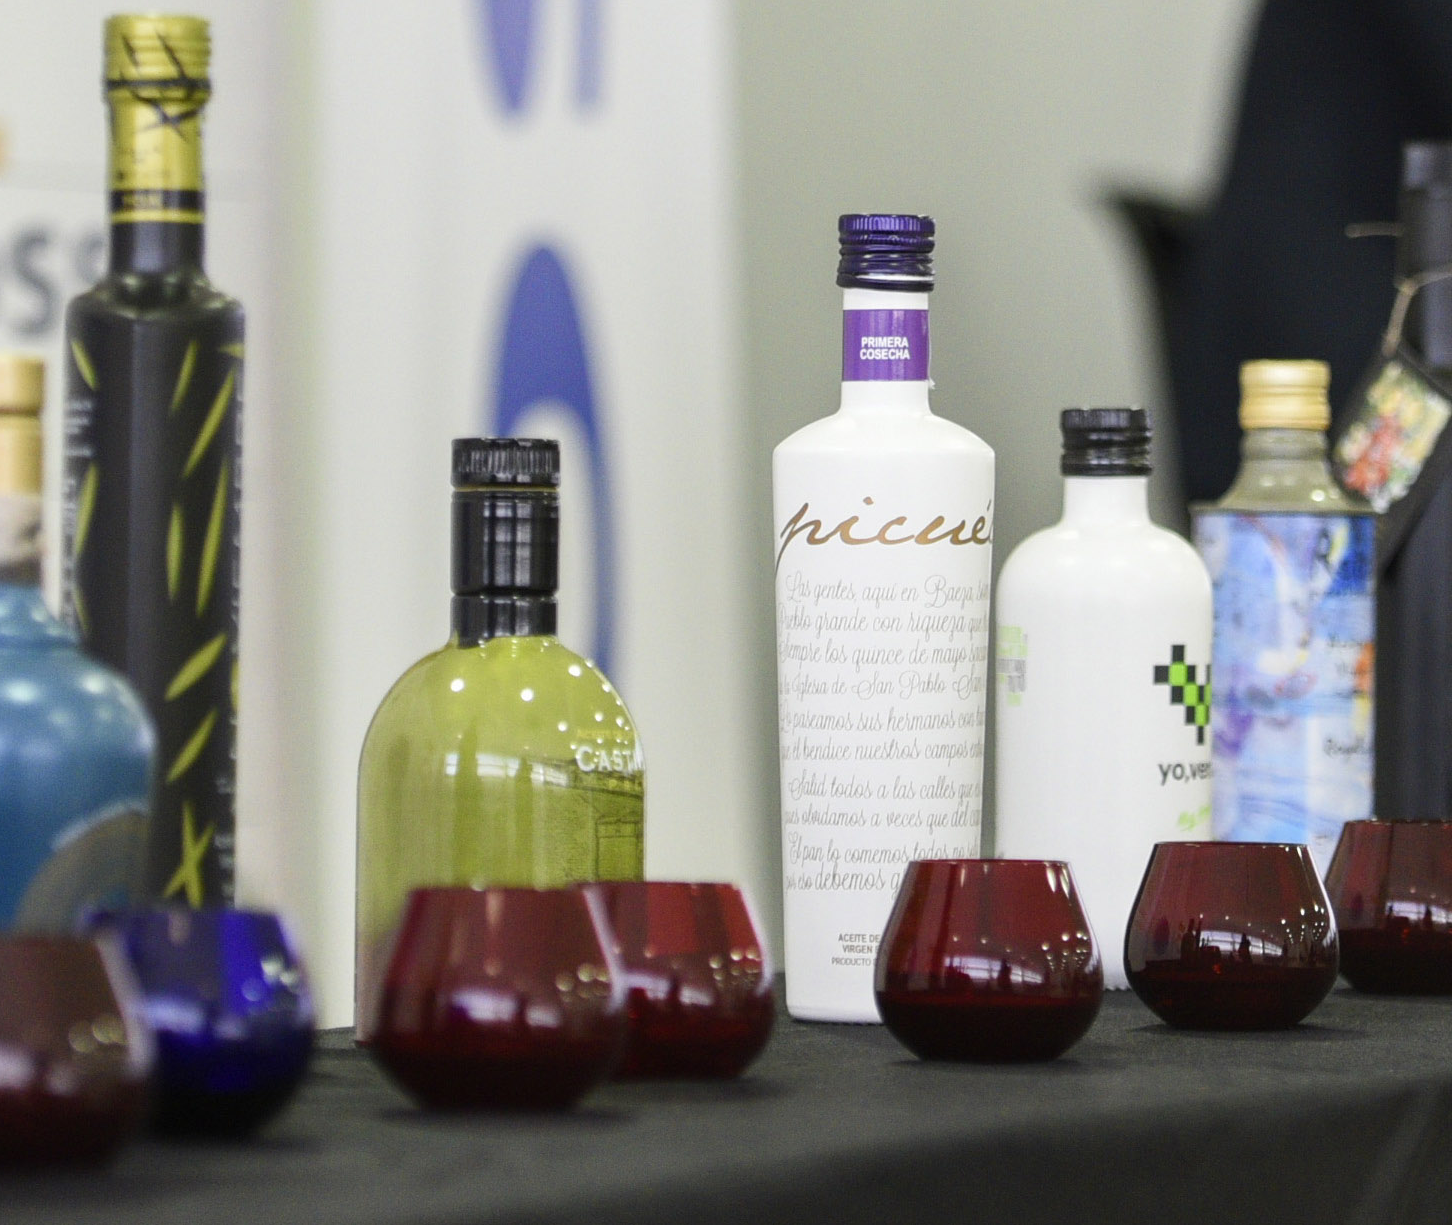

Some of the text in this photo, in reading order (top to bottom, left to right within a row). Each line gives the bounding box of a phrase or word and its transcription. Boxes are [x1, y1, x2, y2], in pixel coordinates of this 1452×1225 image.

[861, 337, 909, 348] PRIMERA
[859, 348, 910, 360] COSECHA
[814, 607, 868, 639] grande
[872, 614, 903, 632] con
[824, 637, 847, 664] los
[851, 646, 904, 673] quince
[908, 639, 929, 664] de
[856, 711, 883, 732] sus
[854, 738, 921, 761] nuestros
[830, 773, 873, 800] todos
[877, 783, 889, 800] a
[893, 774, 917, 800] las
[870, 811, 883, 828] a
[886, 809, 923, 828] veces
[926, 812, 949, 836] que
[838, 933, 867, 943] ACEITE
[842, 944, 873, 954] VIRGEN
[831, 957, 872, 966] PRODUCTO
